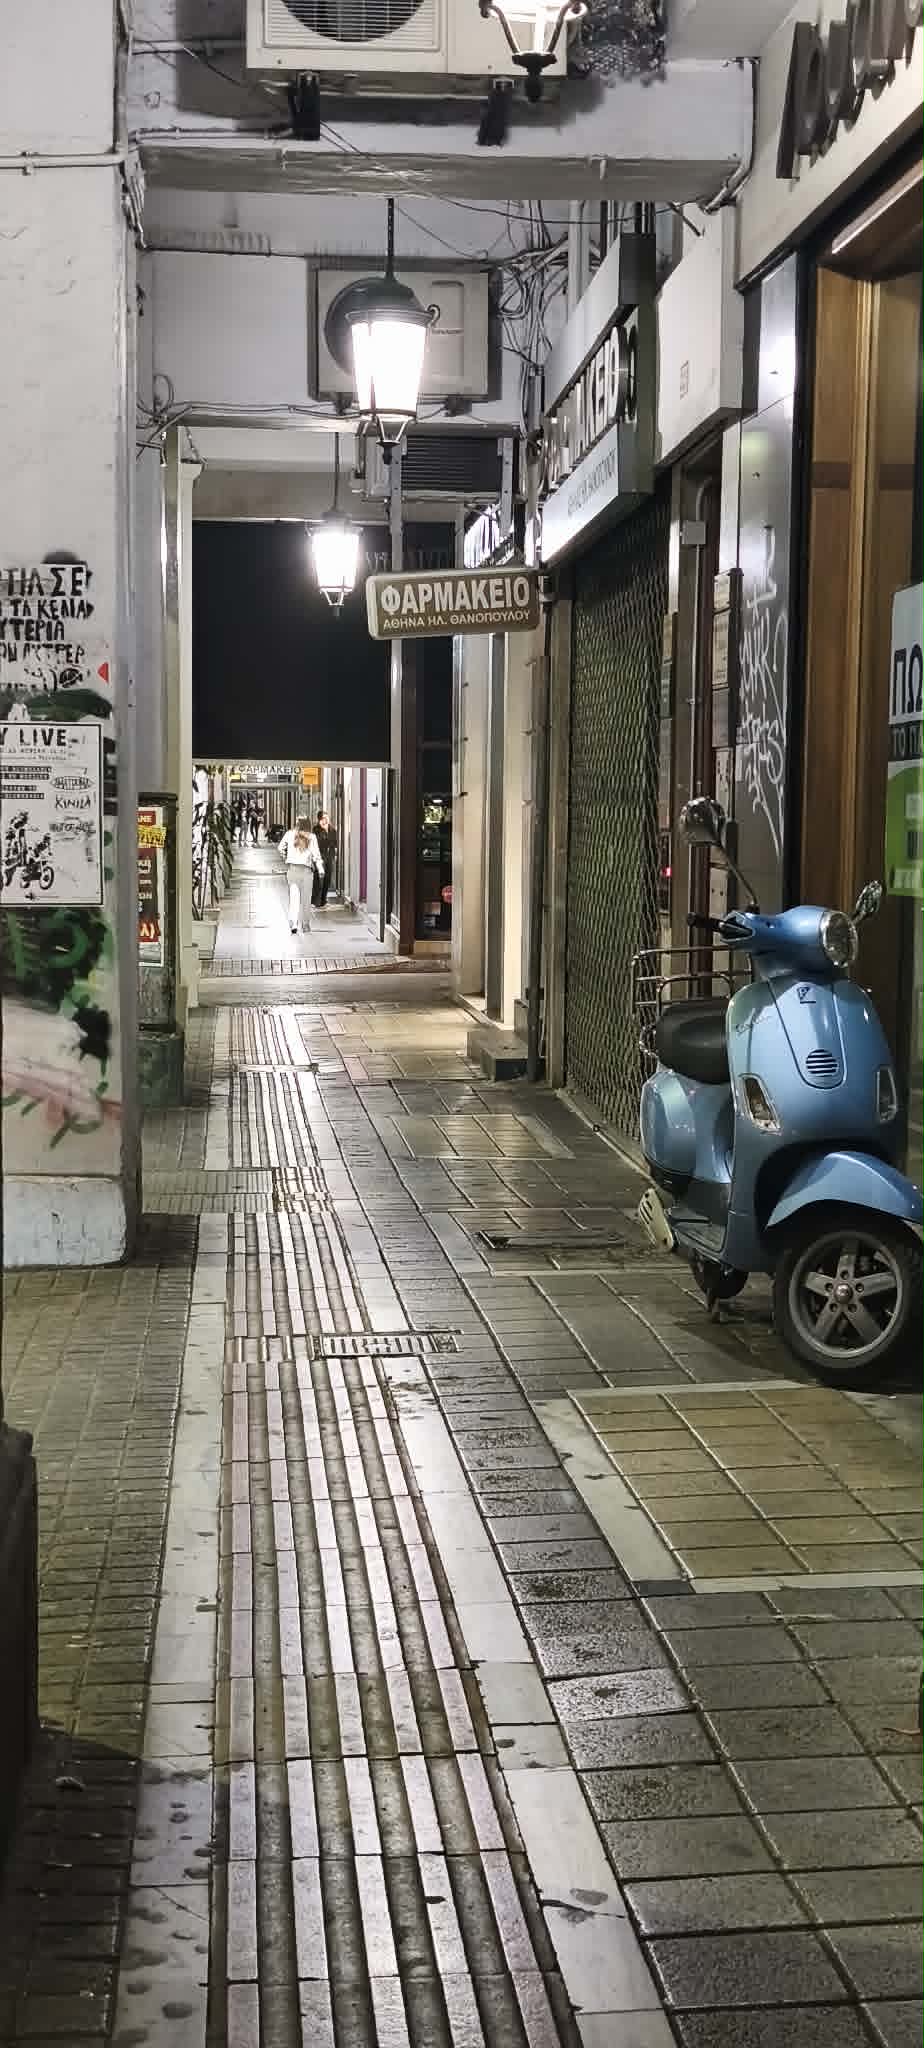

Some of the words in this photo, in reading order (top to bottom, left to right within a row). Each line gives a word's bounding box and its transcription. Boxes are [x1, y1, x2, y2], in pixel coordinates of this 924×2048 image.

[381, 576, 530, 615] ΦΑΡΜΑΚΕΙΟ
[383, 617, 425, 630] ΑΘΗΝΑ
[428, 616, 447, 626] ΗΛ.
[450, 610, 531, 625] ΘΑΝΟΠΟΥΛΟΥ
[19, 728, 67, 747] LIVE
